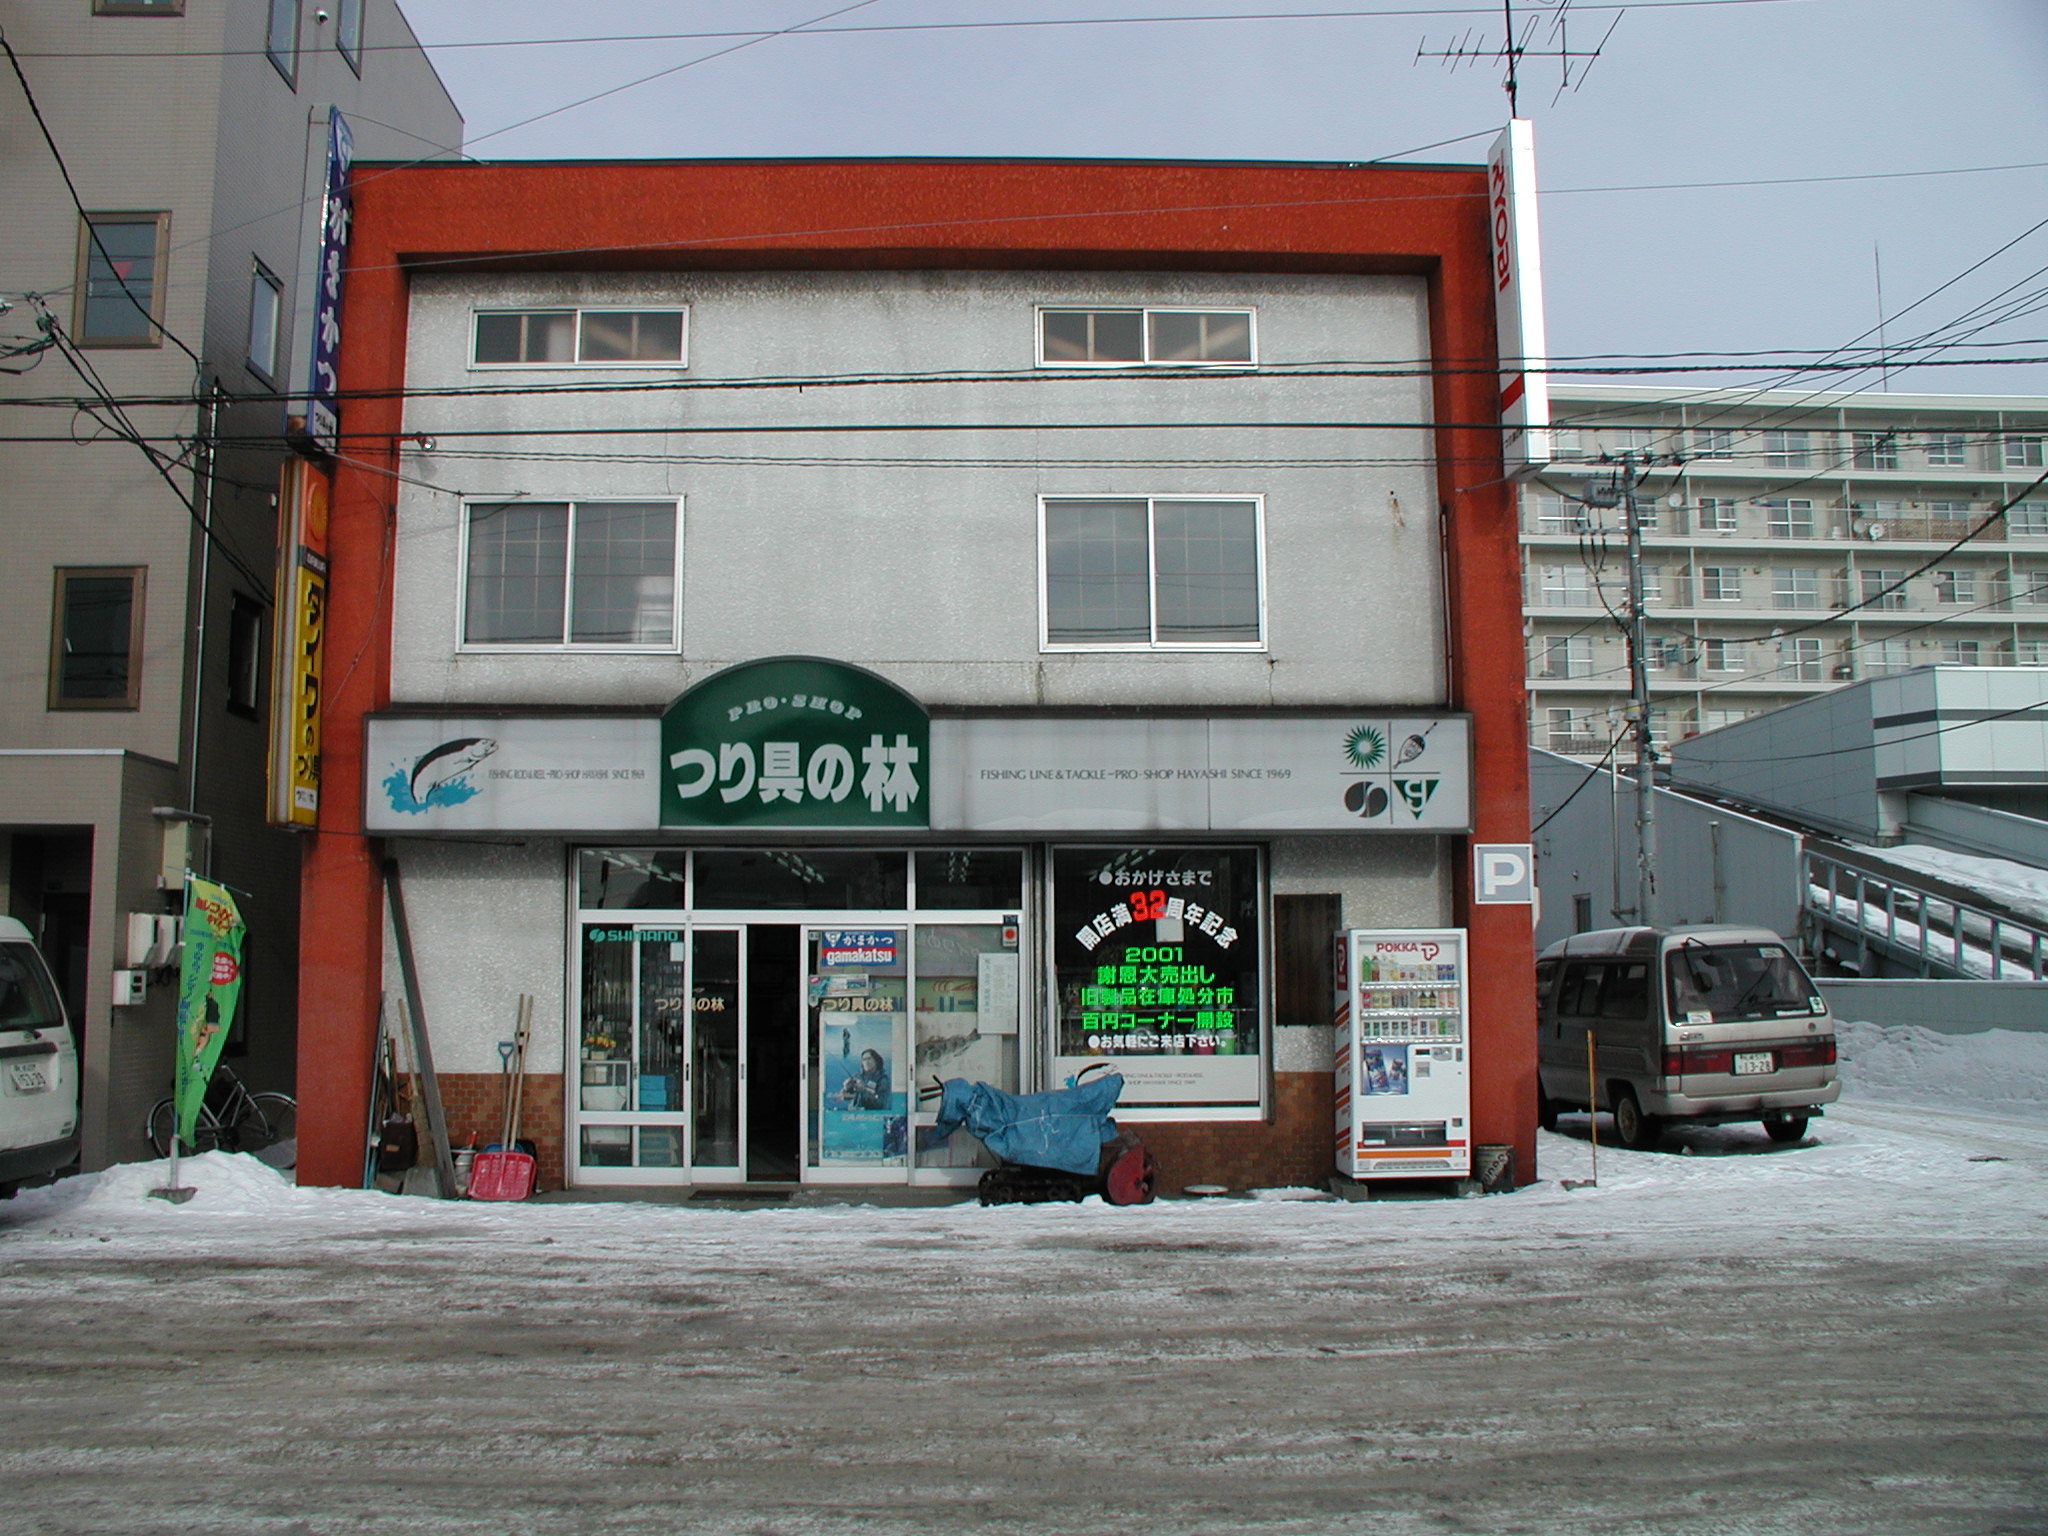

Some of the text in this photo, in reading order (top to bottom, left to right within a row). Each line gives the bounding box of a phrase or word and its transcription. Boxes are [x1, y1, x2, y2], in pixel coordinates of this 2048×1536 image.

[1491, 148, 1511, 293] RYOBI
[316, 195, 352, 397] がまかつ
[669, 733, 920, 813] つり具の林
[979, 768, 1027, 781] FISHING
[1177, 768, 1228, 780] HAYASHI
[1231, 768, 1263, 780] SINCE
[1266, 768, 1292, 780] 1969
[1482, 852, 1526, 896] P
[607, 929, 679, 943] SHIMANO
[842, 934, 894, 947] がまかつ
[826, 947, 893, 966] gamakatsu
[1124, 946, 1184, 963] 2001
[1376, 942, 1419, 953] POKKA
[1096, 964, 1216, 986] 謝恩大売出し
[822, 997, 894, 1012] つり具の林
[1081, 986, 1236, 1007] 旧製品在庫処分市
[1081, 1011, 1235, 1031] 百円コーナー開設
